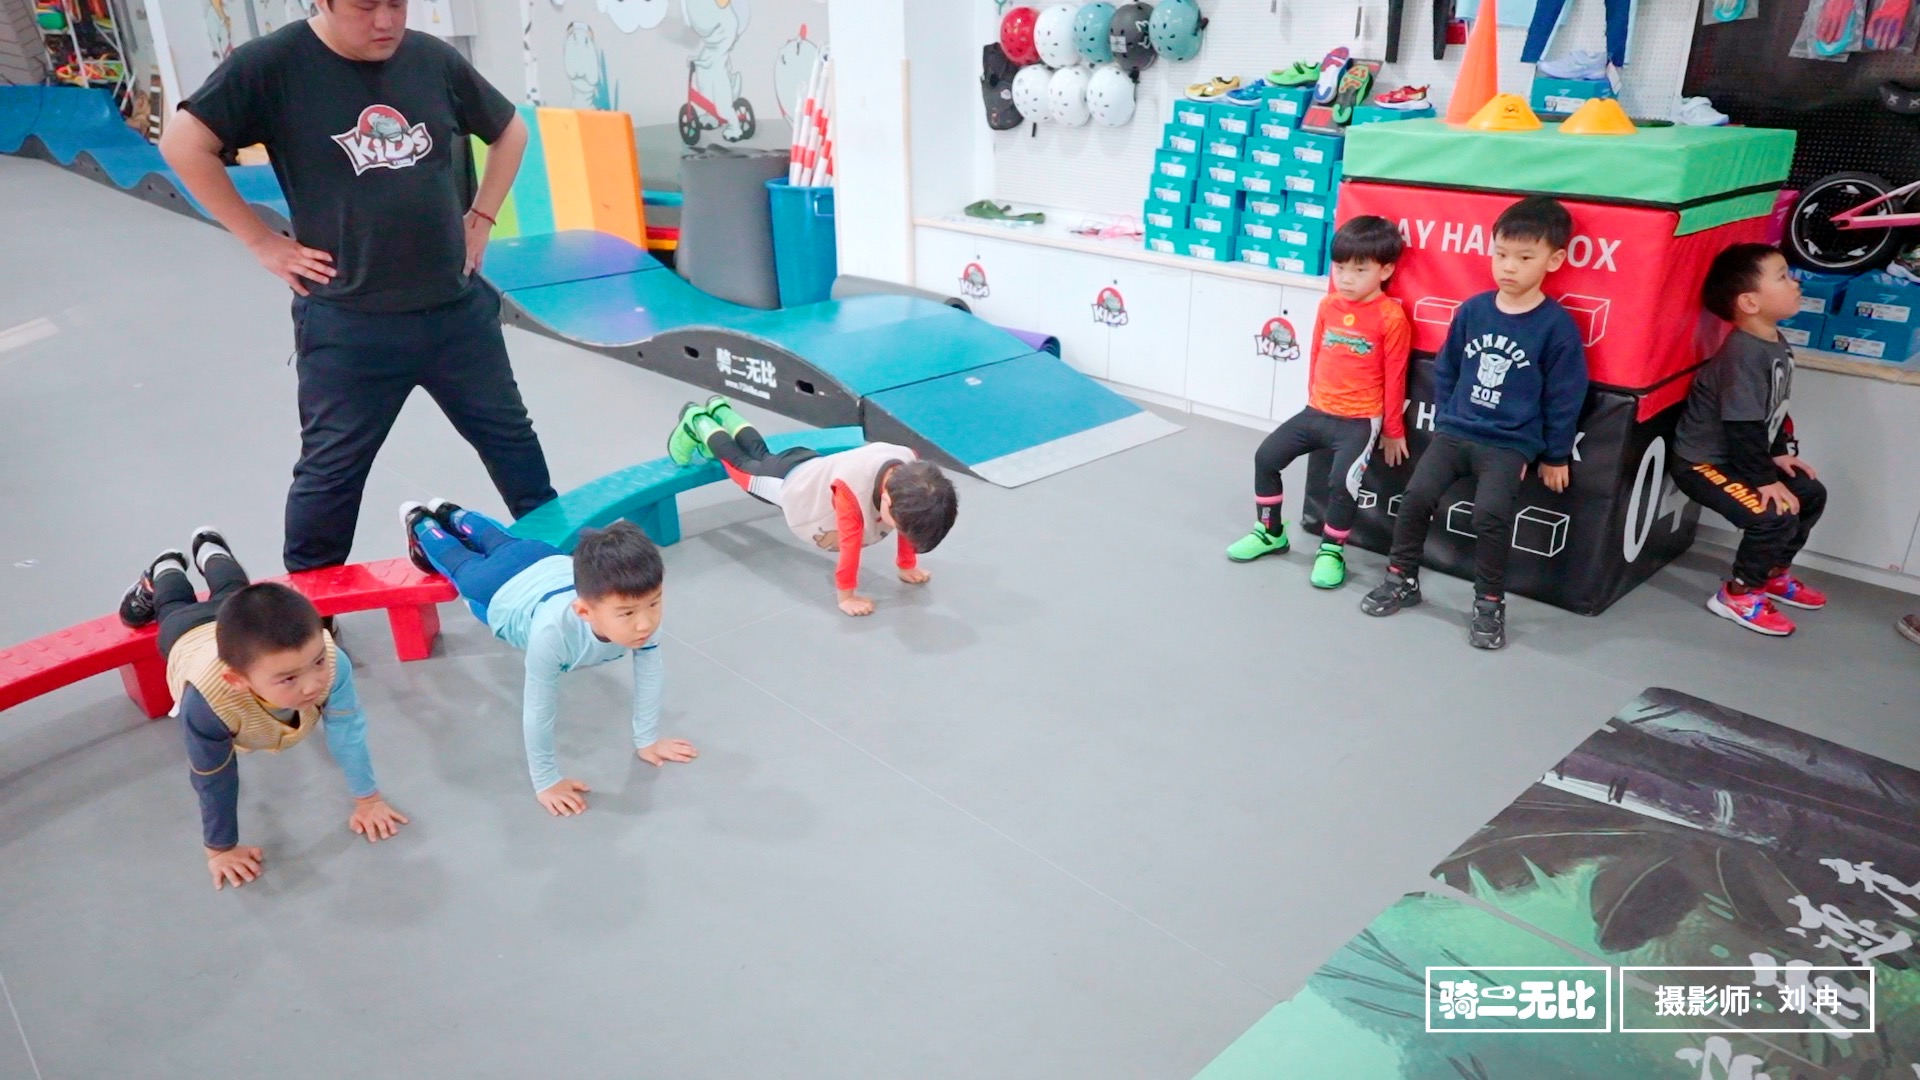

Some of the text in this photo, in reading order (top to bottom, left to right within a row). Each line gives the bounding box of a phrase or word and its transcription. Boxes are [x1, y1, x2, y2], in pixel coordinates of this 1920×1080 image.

[1397, 218, 1622, 272] AY HA OX
[1723, 482, 1767, 514] China
